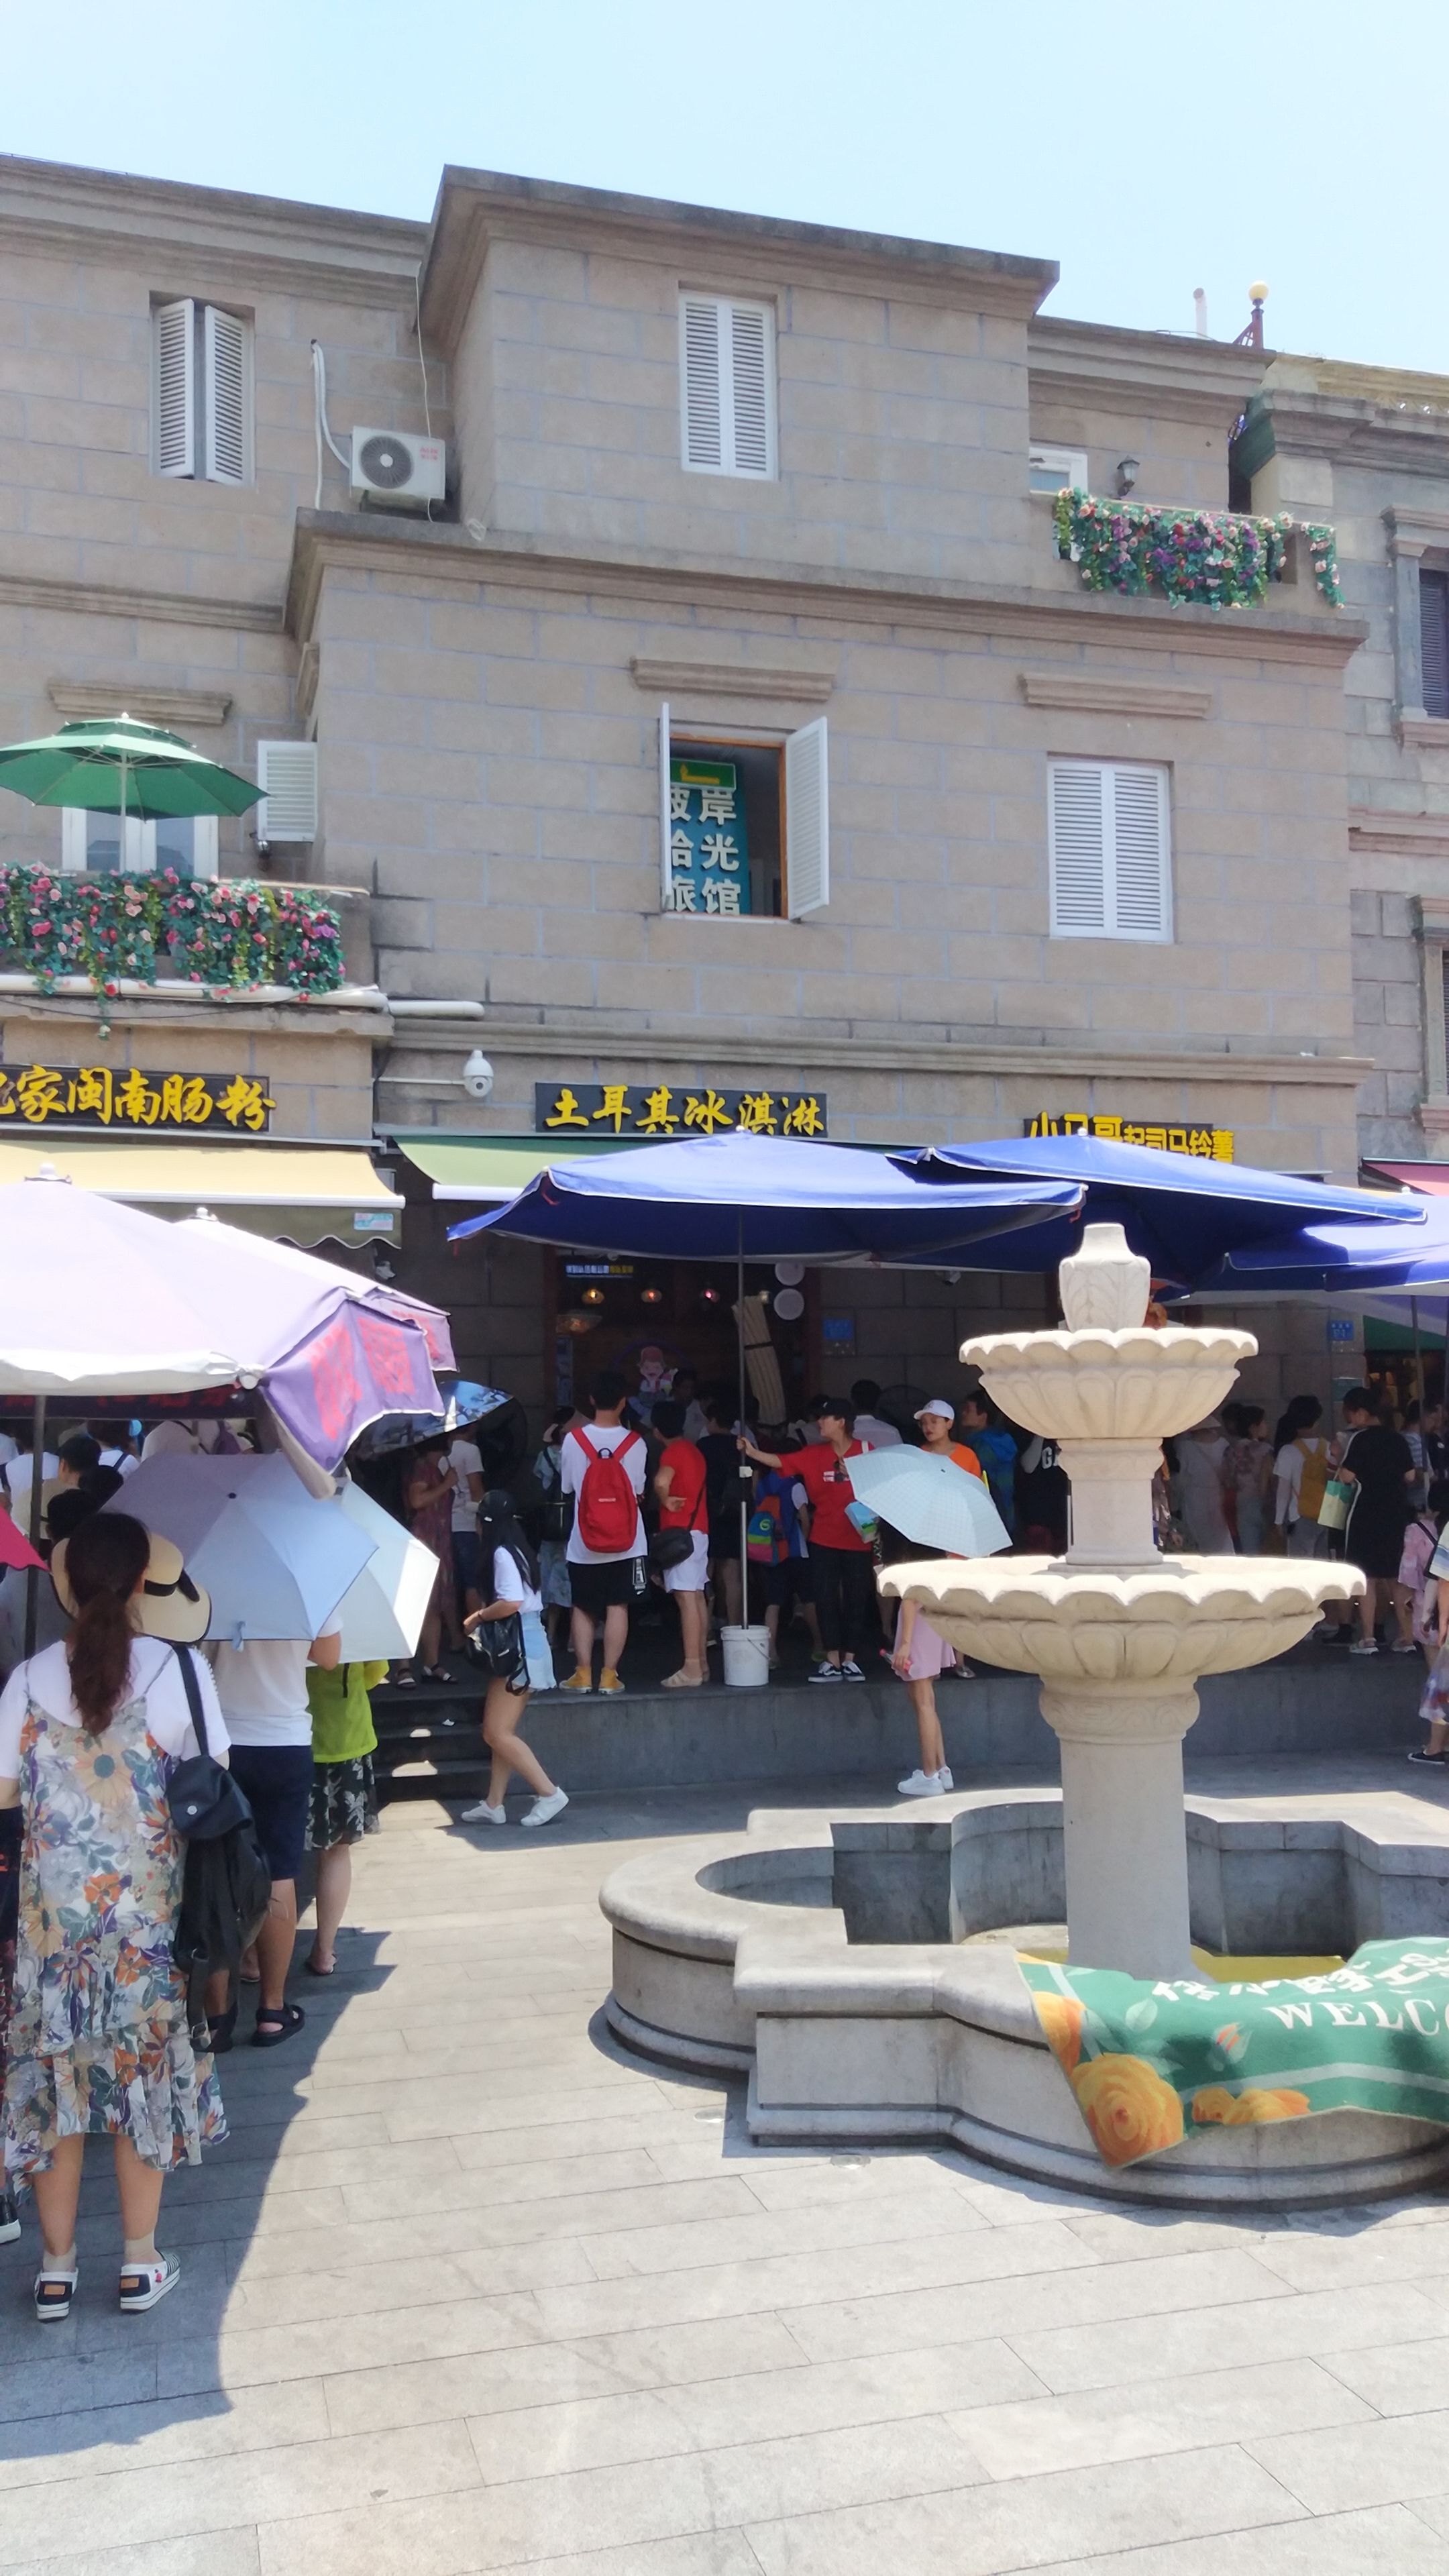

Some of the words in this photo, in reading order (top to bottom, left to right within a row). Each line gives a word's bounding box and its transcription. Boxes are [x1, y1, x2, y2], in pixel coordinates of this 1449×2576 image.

[672, 875, 741, 915] 旅馆
[545, 1084, 824, 1136] 土耳其冰淇淋
[1262, 1998, 1449, 2036] WELC
